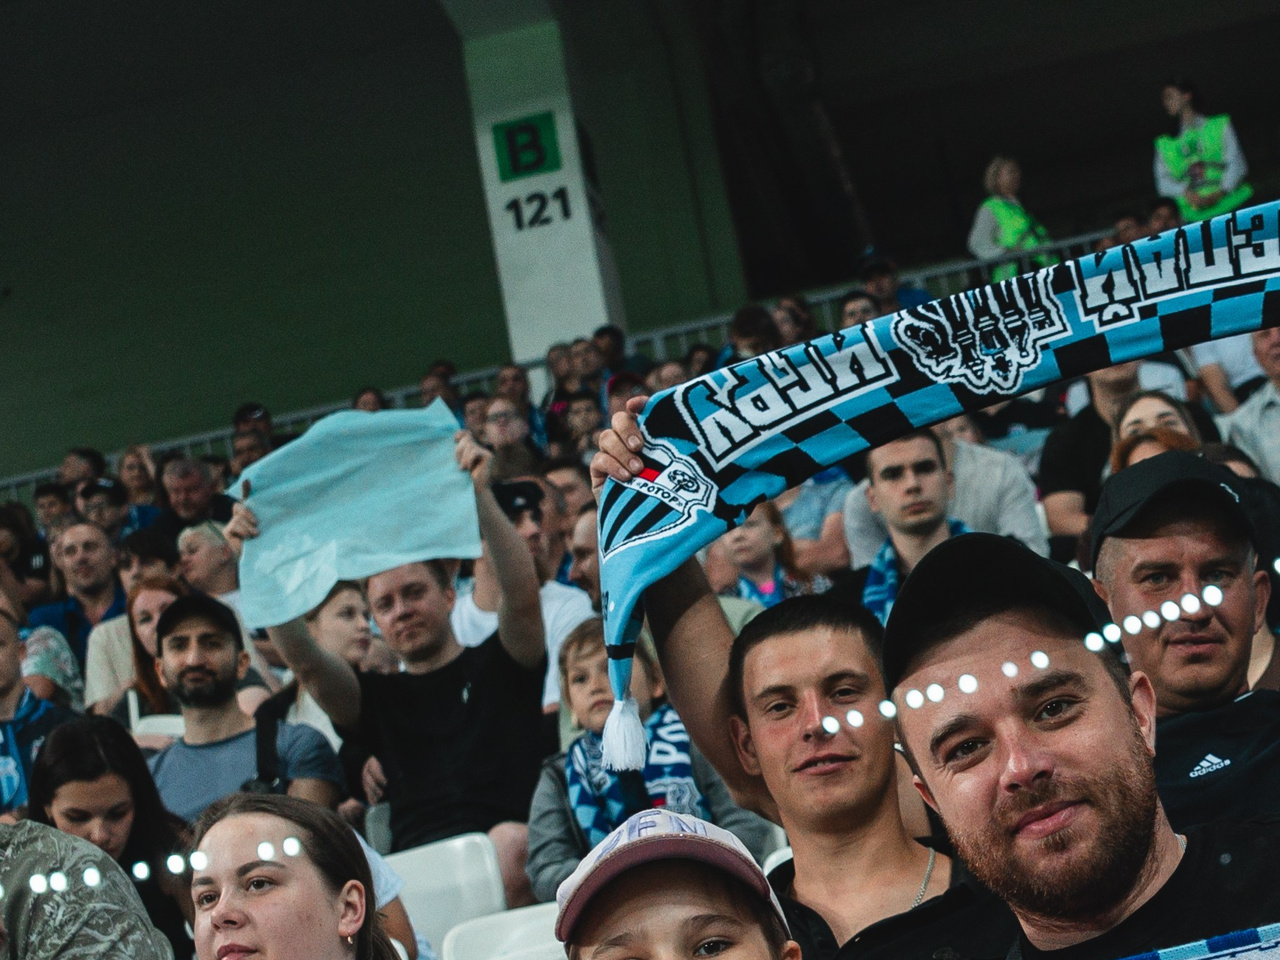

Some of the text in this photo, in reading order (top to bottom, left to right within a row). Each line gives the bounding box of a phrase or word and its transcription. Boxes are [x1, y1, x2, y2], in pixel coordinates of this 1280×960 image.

[505, 122, 546, 174] B
[506, 186, 572, 230] 121
[685, 321, 888, 456] ИГРУ
[1189, 759, 1231, 778] adidas
